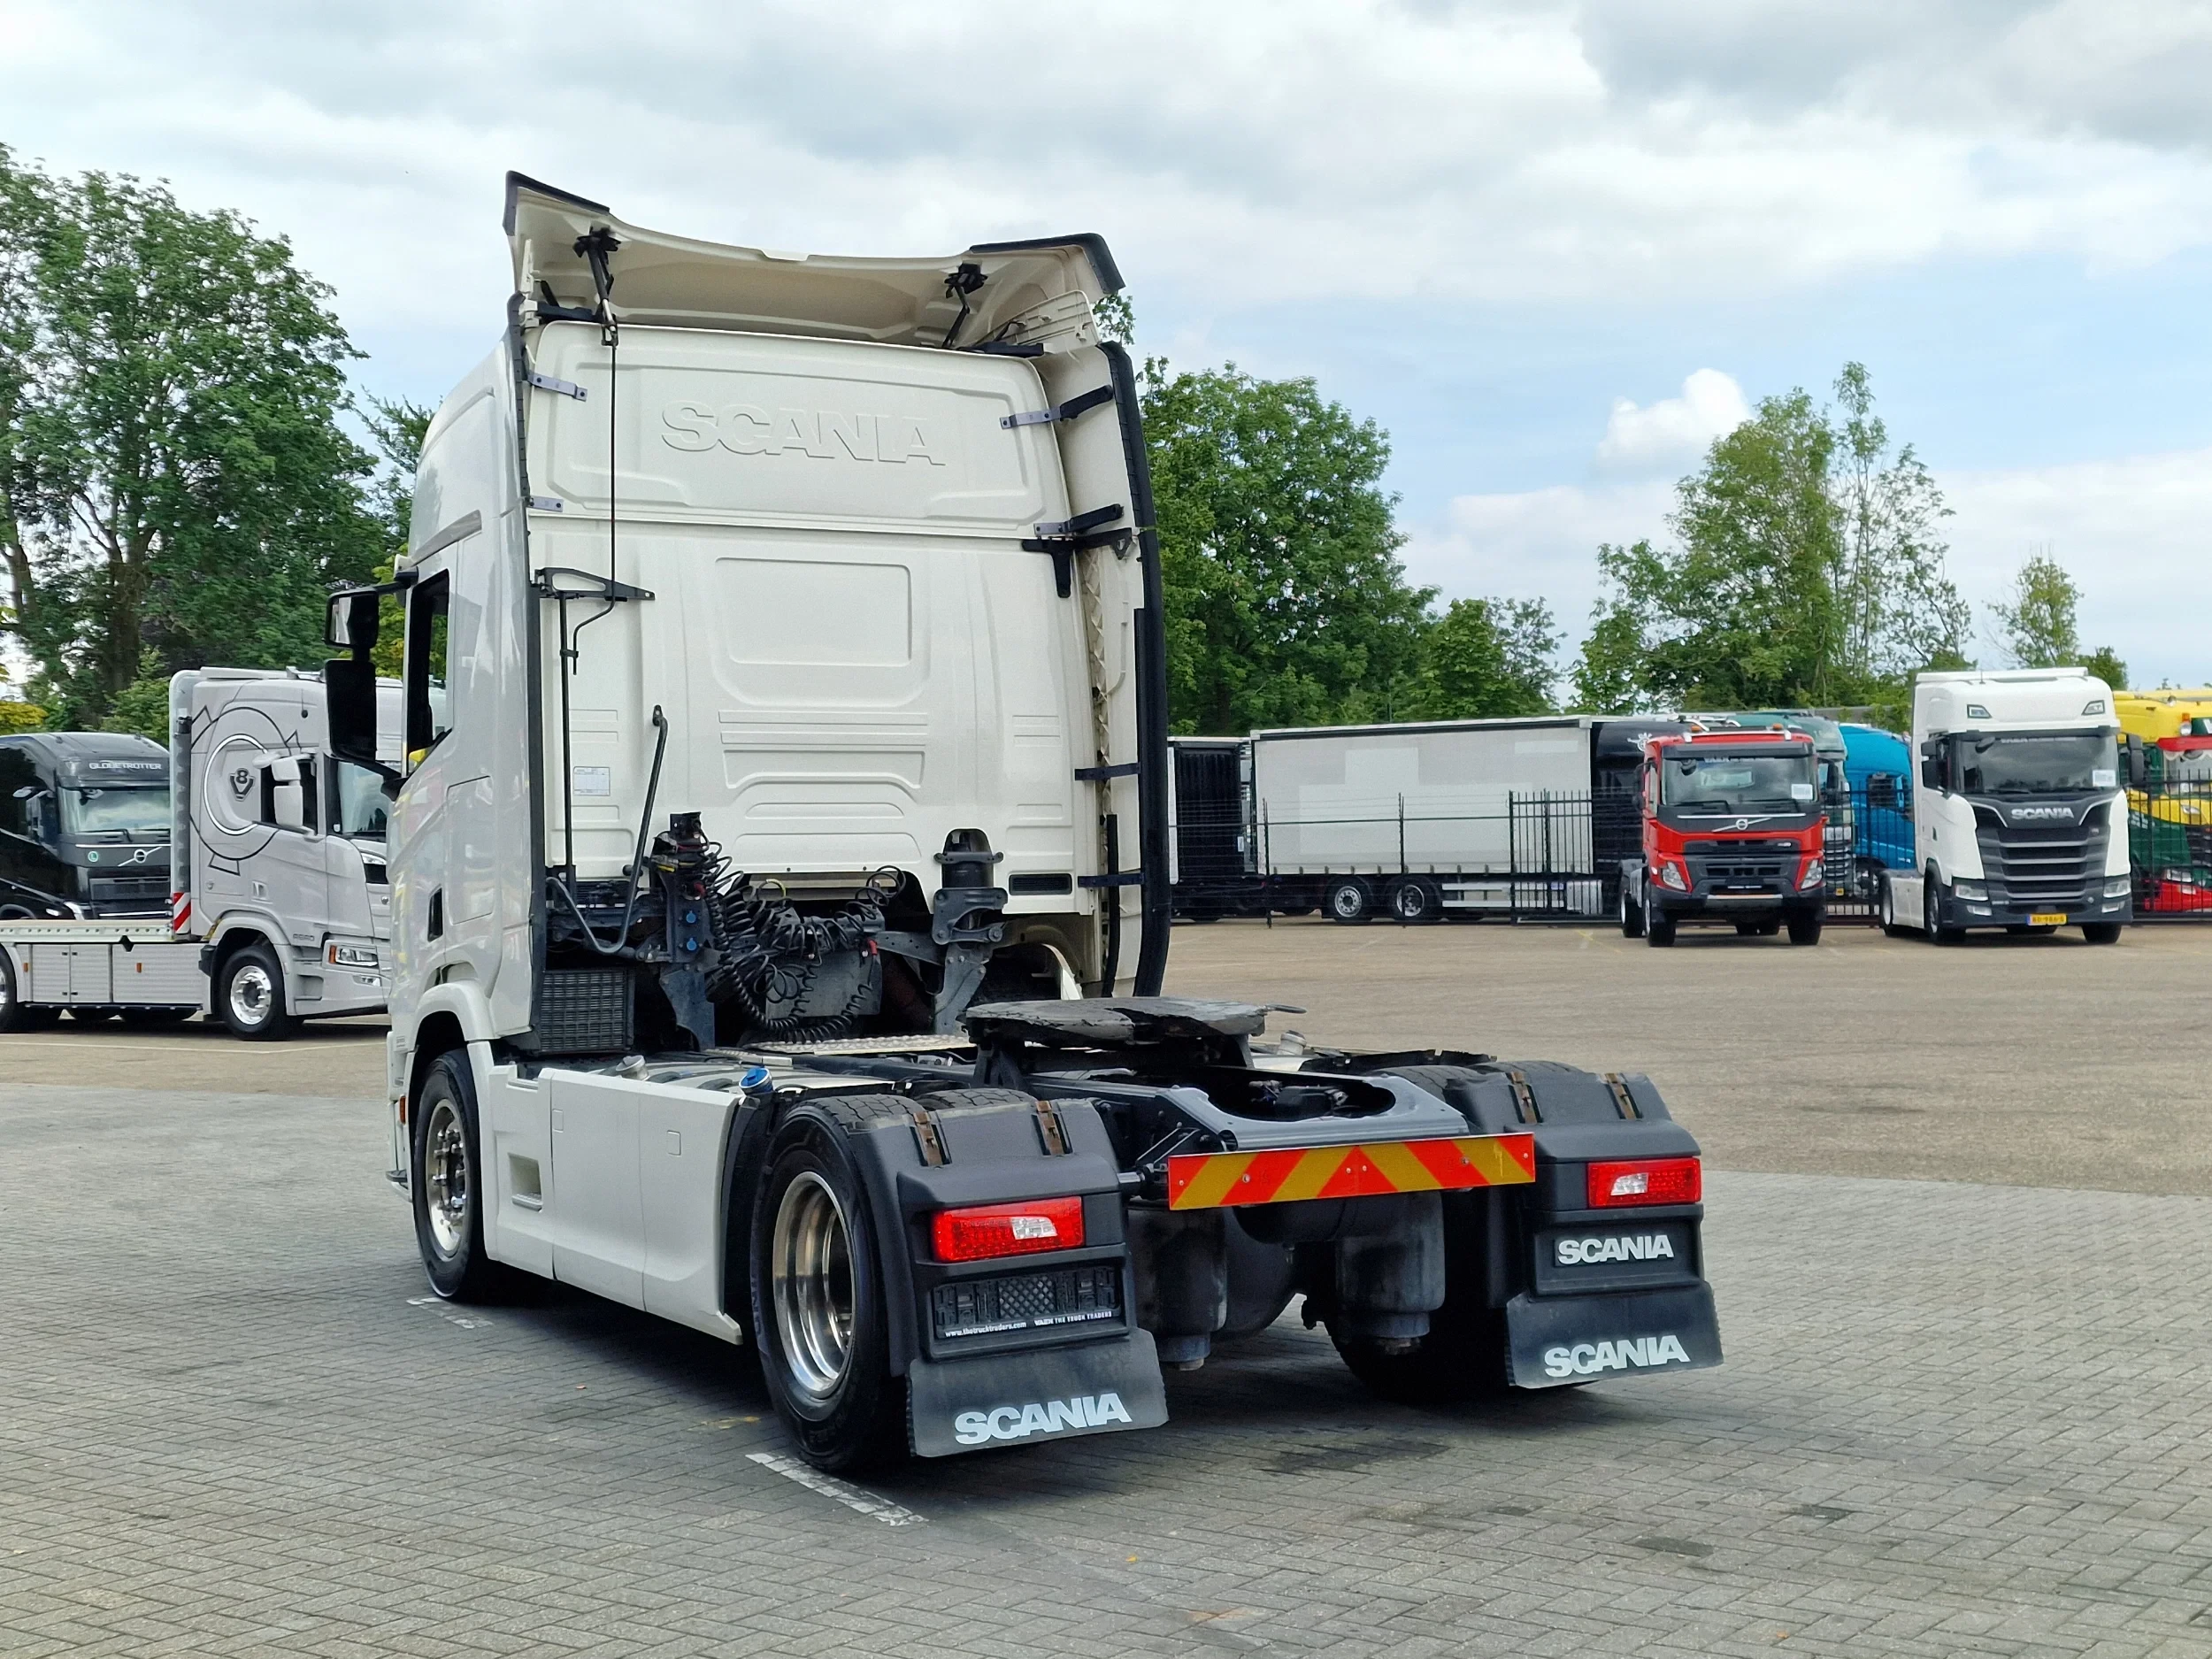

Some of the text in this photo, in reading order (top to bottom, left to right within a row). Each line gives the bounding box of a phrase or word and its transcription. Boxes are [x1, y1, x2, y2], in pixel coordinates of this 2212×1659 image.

[661, 400, 946, 466] SCANIA
[2011, 807, 2075, 819] SCANIA
[1557, 1234, 1675, 1265] SCANIA
[1544, 1334, 1691, 1378] SCANIA
[954, 1392, 1133, 1445] SCANIA
